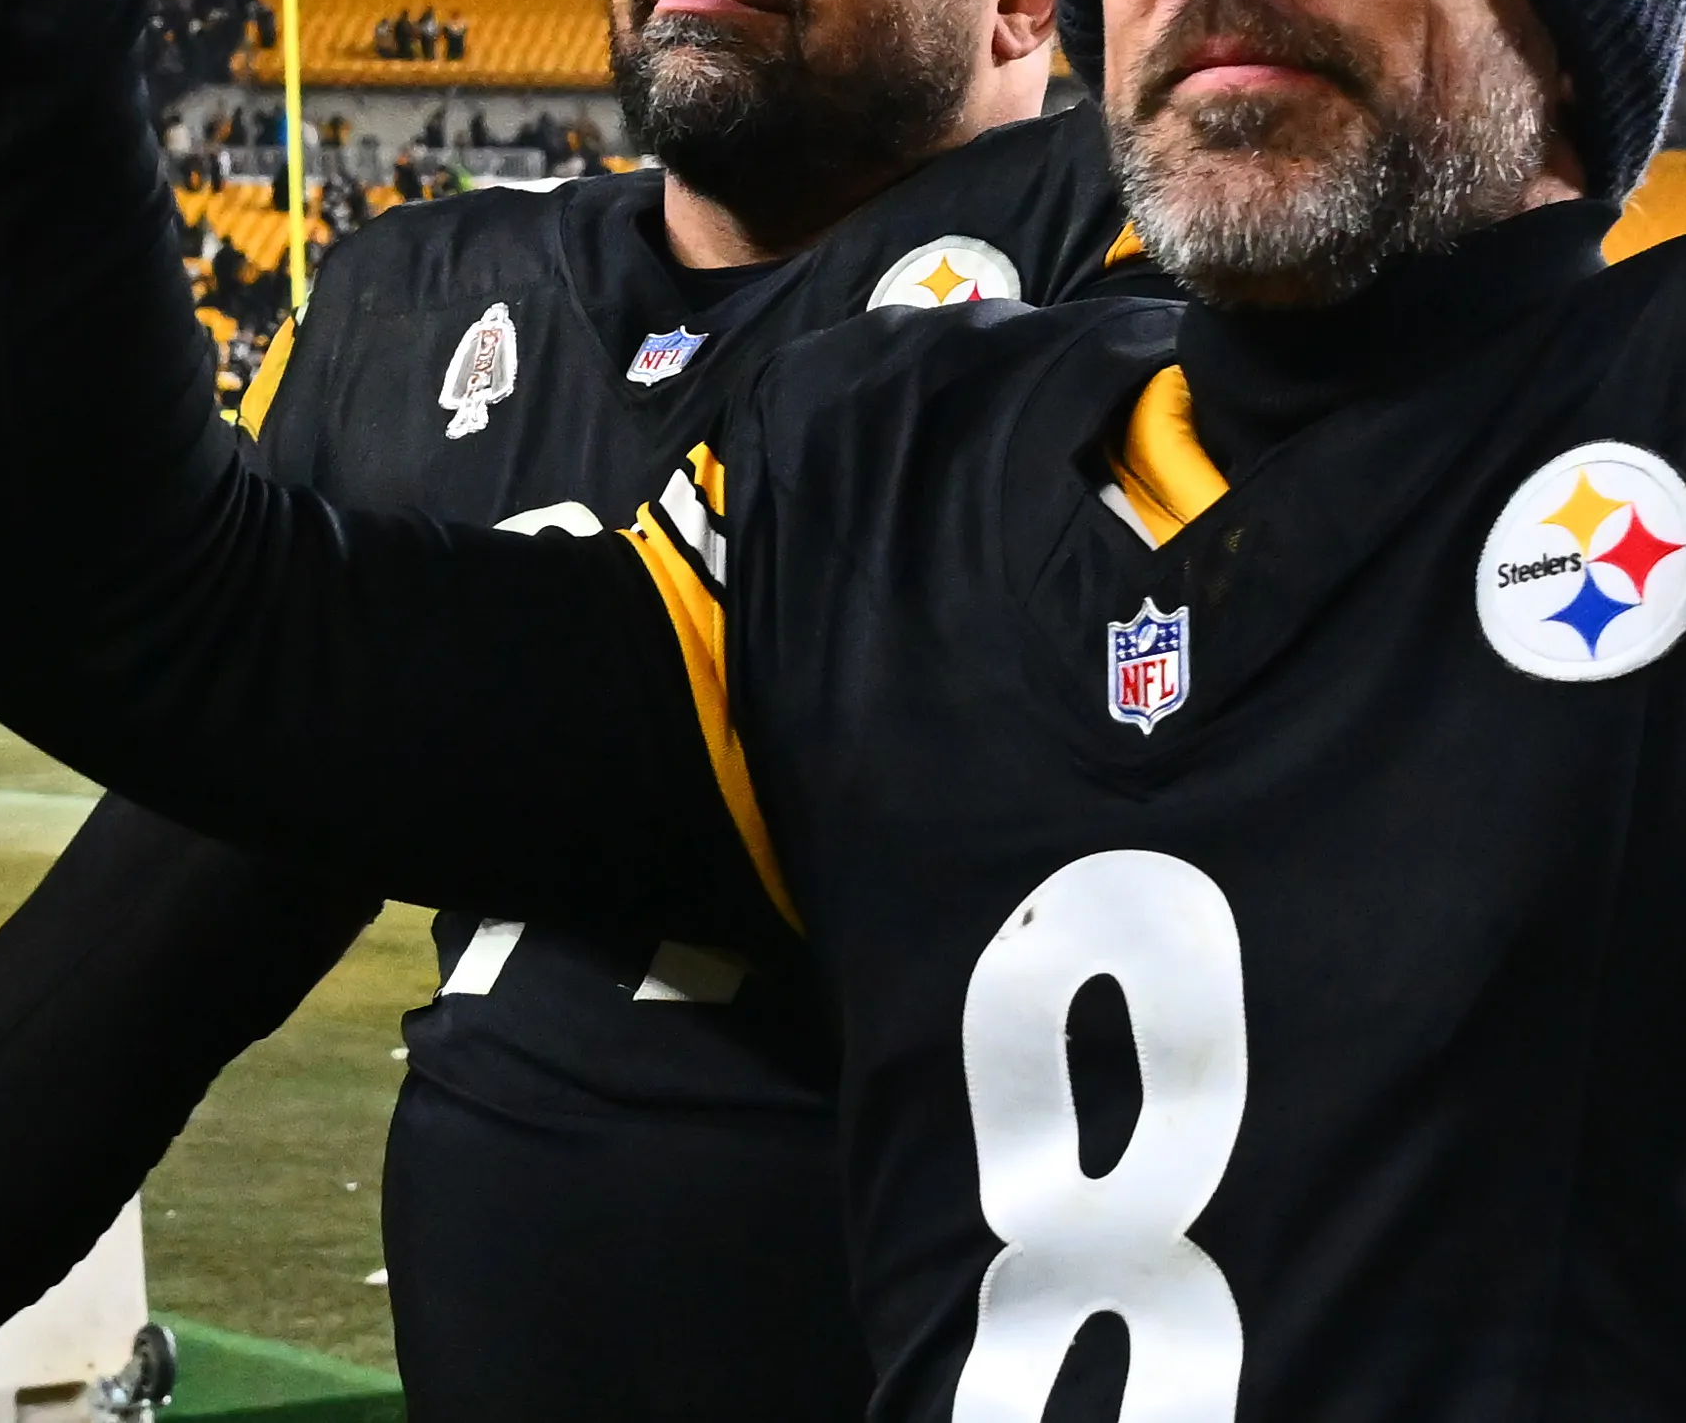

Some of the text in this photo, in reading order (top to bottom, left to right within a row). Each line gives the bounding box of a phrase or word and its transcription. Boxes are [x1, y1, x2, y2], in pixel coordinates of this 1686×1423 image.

[639, 348, 683, 370] NFL
[1497, 552, 1582, 589] Steelers
[1121, 658, 1175, 709] NFL
[950, 848, 1248, 1423] 8
